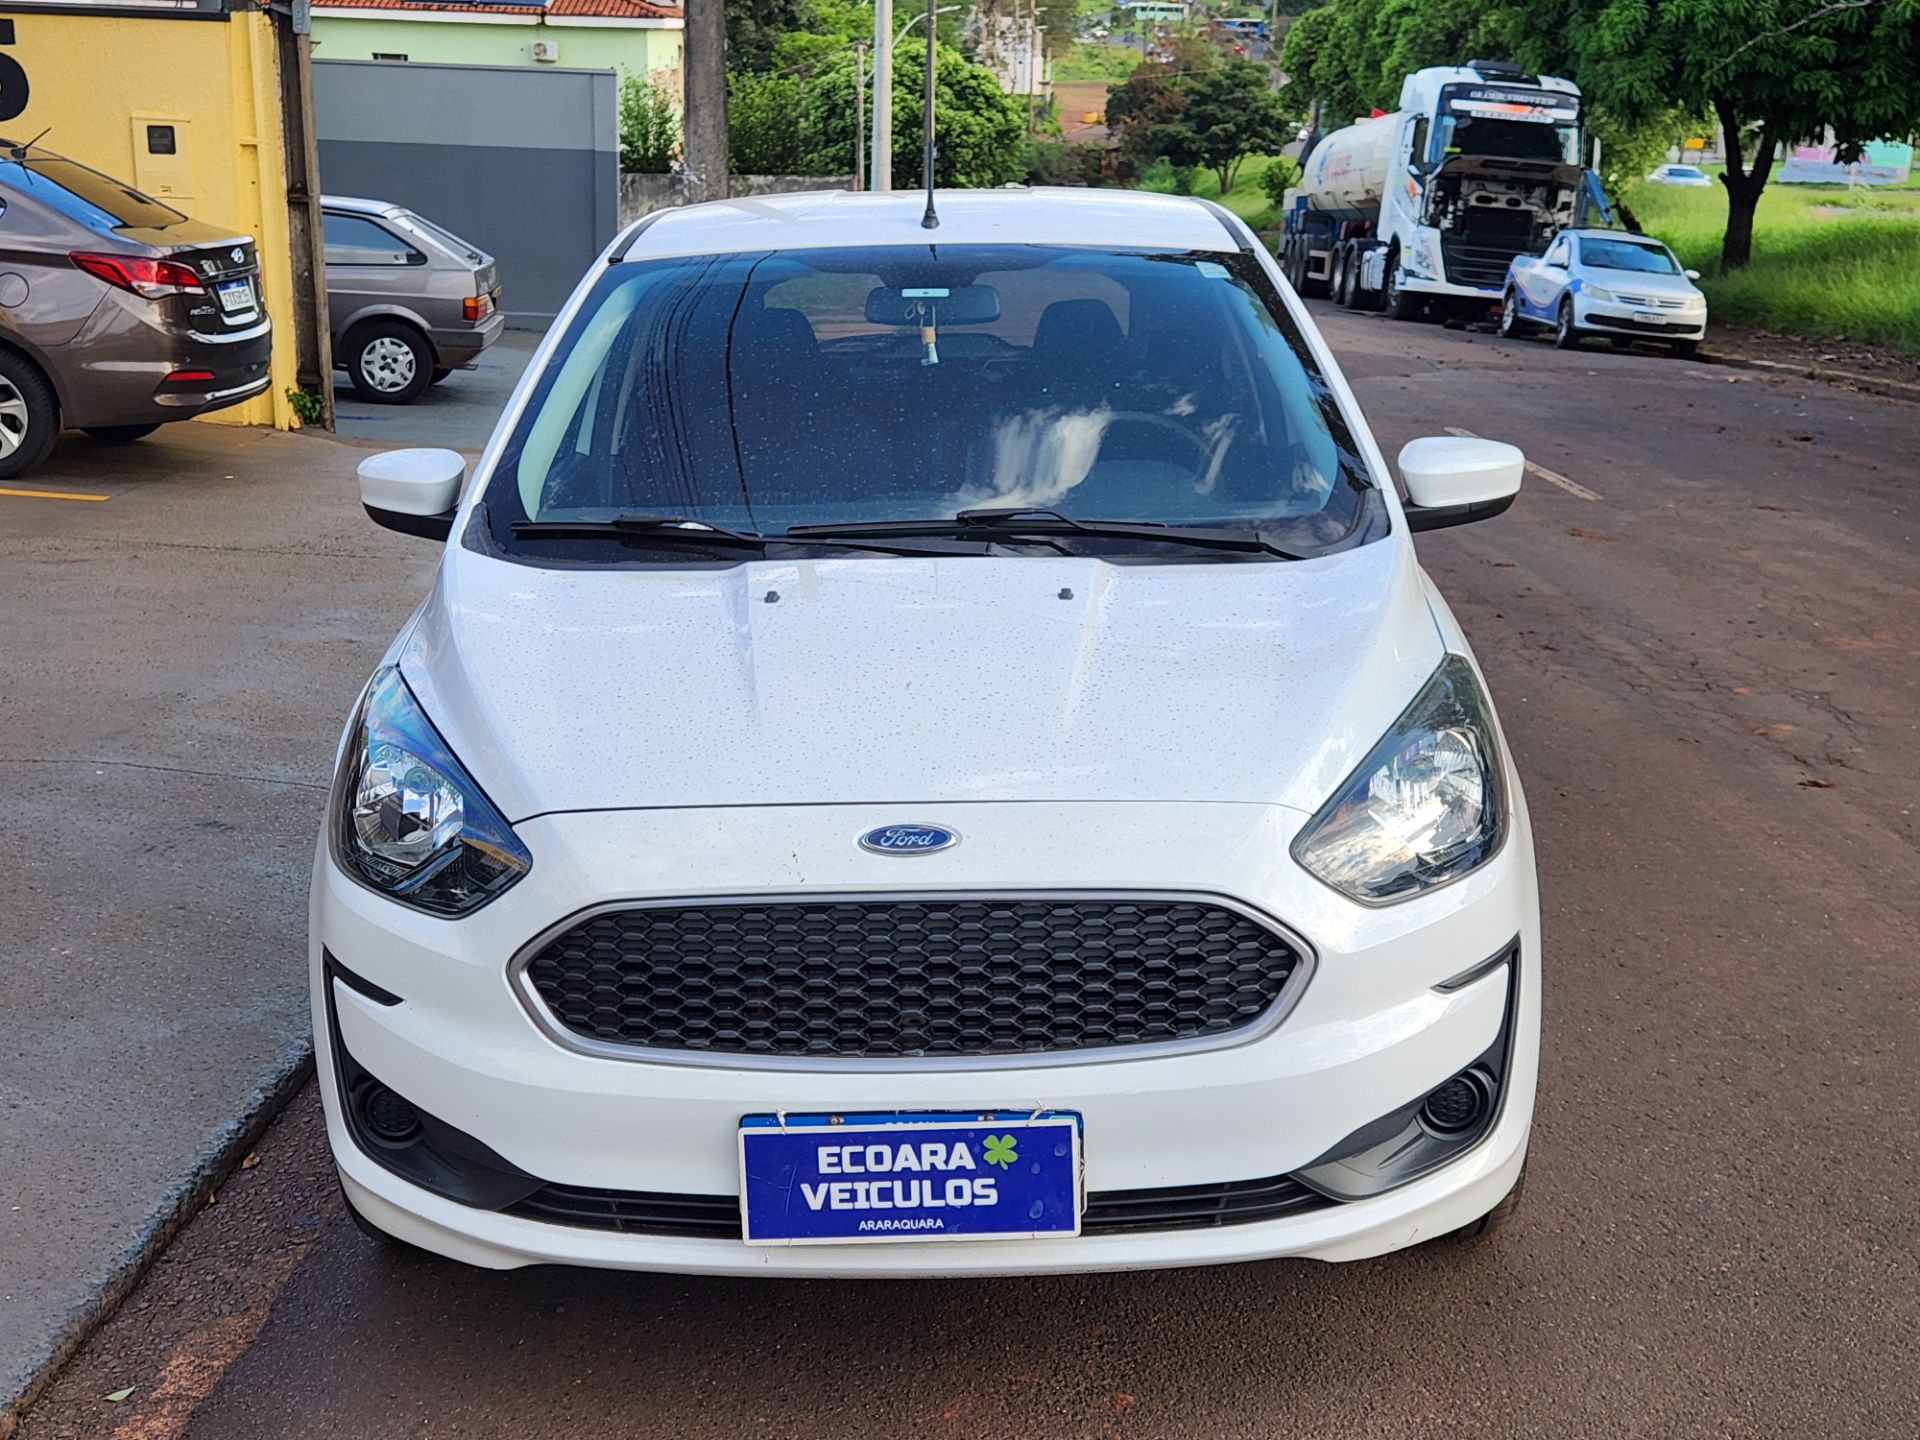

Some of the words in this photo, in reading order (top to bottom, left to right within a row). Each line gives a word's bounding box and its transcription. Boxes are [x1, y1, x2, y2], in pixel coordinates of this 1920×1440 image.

[880, 828, 935, 847] Ford
[819, 1143, 975, 1173] ECOARA
[801, 1179, 997, 1209] VEICULOS
[859, 1219, 943, 1230] ARARAQUARA
